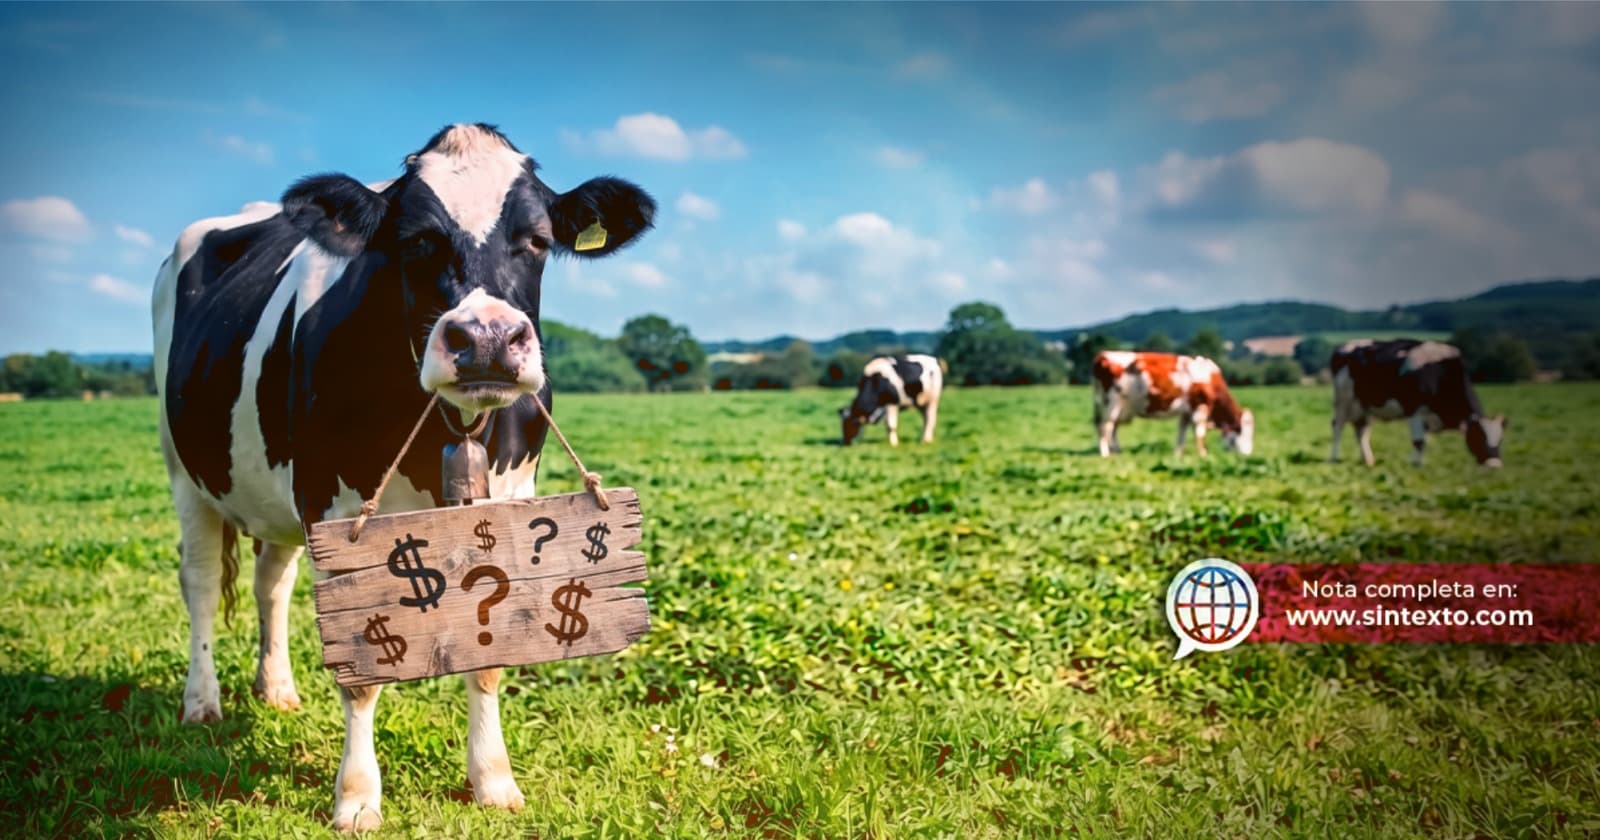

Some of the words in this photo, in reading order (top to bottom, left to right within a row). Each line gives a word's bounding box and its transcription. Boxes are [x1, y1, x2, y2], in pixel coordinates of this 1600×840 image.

[474, 519, 497, 553] $
[529, 517, 559, 565] ?
[581, 521, 612, 565] $
[387, 533, 447, 613] $
[460, 564, 511, 646] ?
[544, 577, 593, 647] $
[363, 613, 408, 666] $
